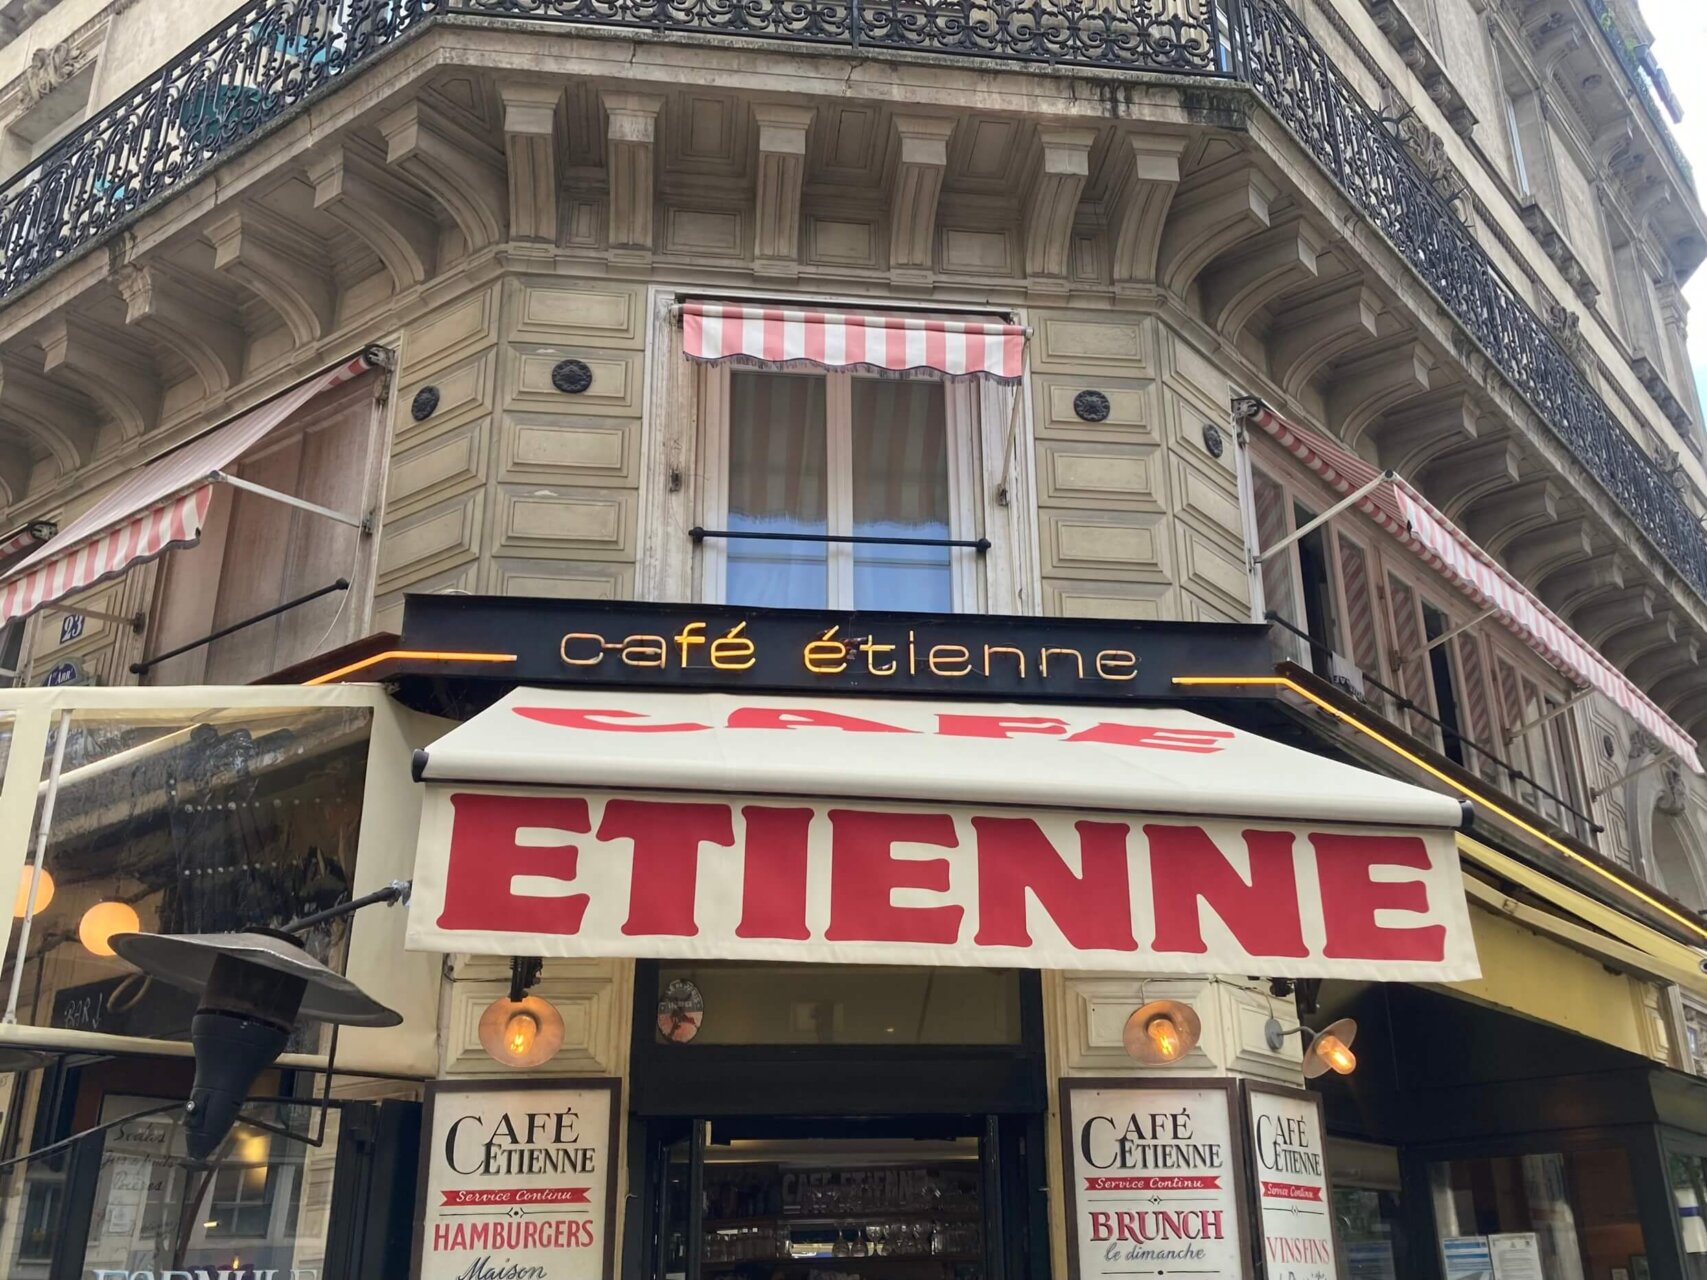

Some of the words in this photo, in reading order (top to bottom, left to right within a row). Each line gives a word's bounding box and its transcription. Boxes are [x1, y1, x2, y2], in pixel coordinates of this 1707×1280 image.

[61, 613, 83, 642] 23
[559, 621, 757, 671] café
[802, 624, 1140, 681] étienne
[511, 705, 1236, 754] CAFE
[435, 792, 1447, 964] ETIENNE
[445, 1107, 581, 1175] CAFÉ
[1081, 1107, 1195, 1170] CAFÉ
[1255, 1114, 1309, 1171] CAFÉ
[456, 1190, 511, 1203] Service
[515, 1189, 573, 1201] Continu
[1095, 1177, 1145, 1189] Service
[1149, 1176, 1205, 1189] Continu
[1267, 1184, 1289, 1197] Service
[1290, 1186, 1314, 1198] Continu
[433, 1219, 595, 1252] HAMBURGERS
[1090, 1210, 1225, 1245] BRUNCH
[456, 1255, 548, 1280] Maison
[1104, 1242, 1124, 1261] le
[1126, 1242, 1207, 1261] dimanche
